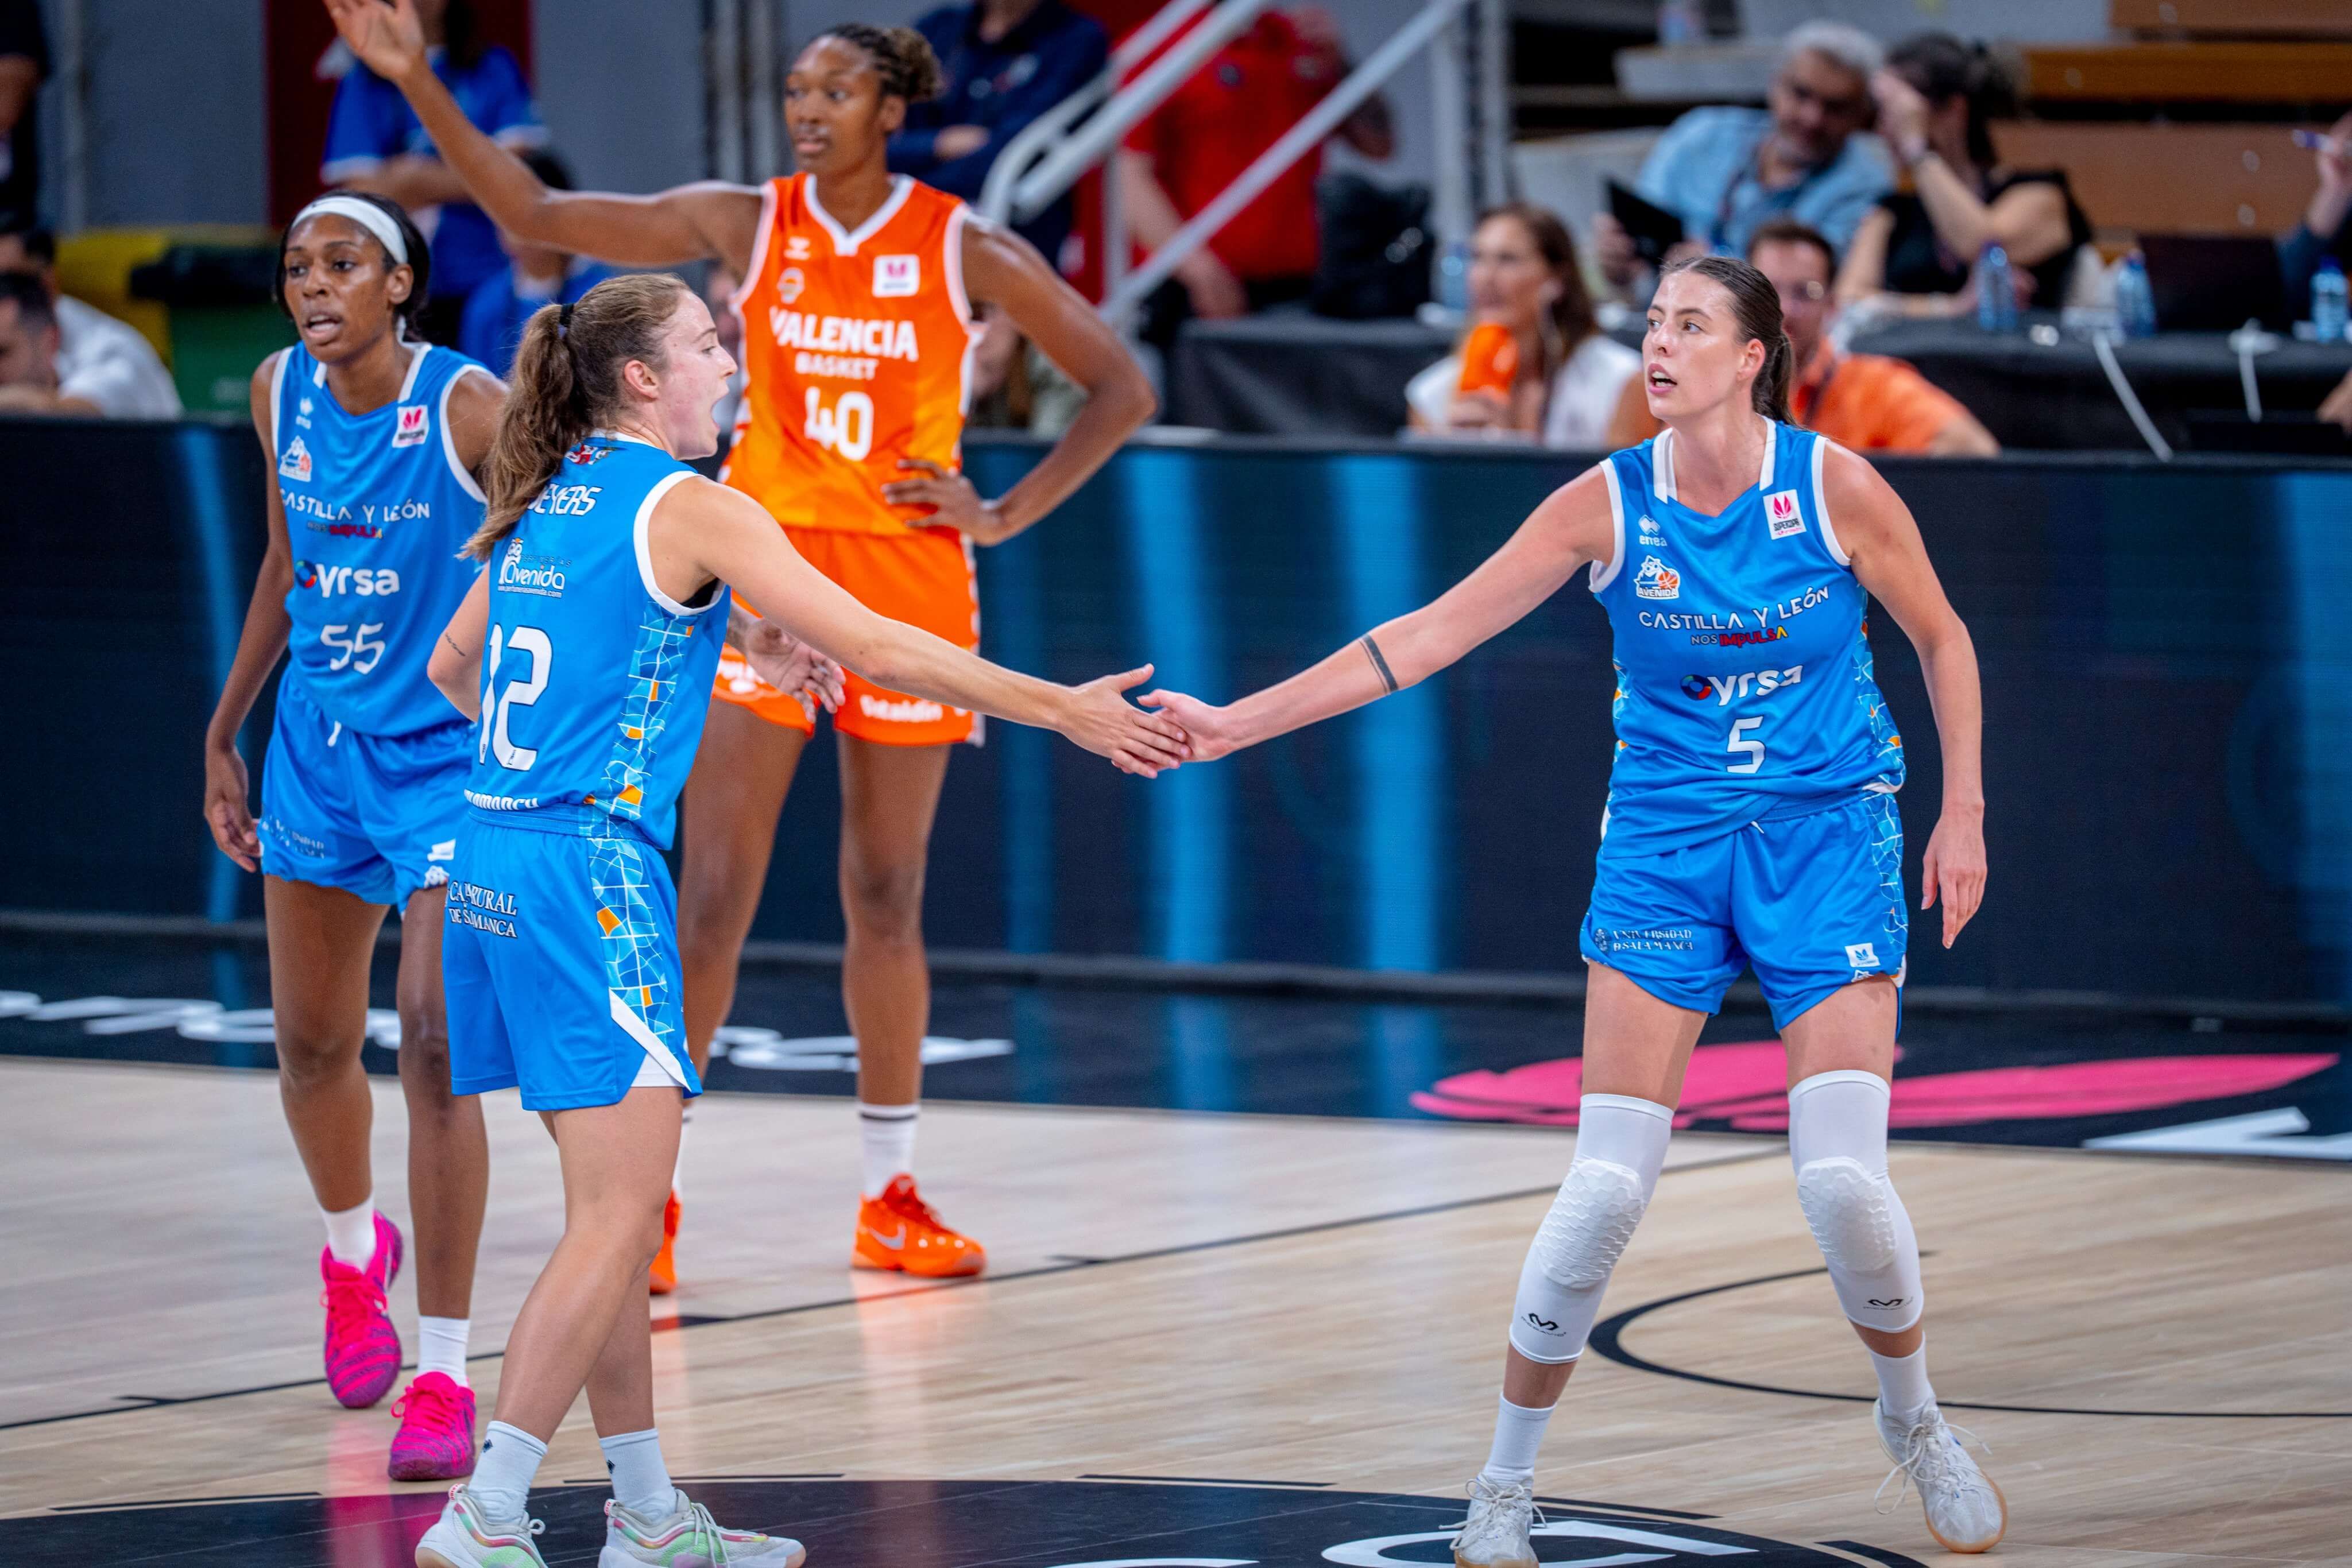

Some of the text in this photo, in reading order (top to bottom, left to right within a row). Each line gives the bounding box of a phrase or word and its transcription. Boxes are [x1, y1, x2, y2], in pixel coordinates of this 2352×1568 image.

[769, 305, 919, 362] VALENCIA
[795, 351, 879, 381] BASKET
[804, 386, 874, 462] 40
[362, 504, 375, 524] Y
[384, 498, 430, 522] LEÓN
[1638, 586, 1829, 630] CASTILLA Y LEÓN
[320, 622, 386, 675] 55
[1691, 634, 1717, 645] NOS
[479, 622, 553, 771] 12
[1727, 715, 1766, 774] 5
